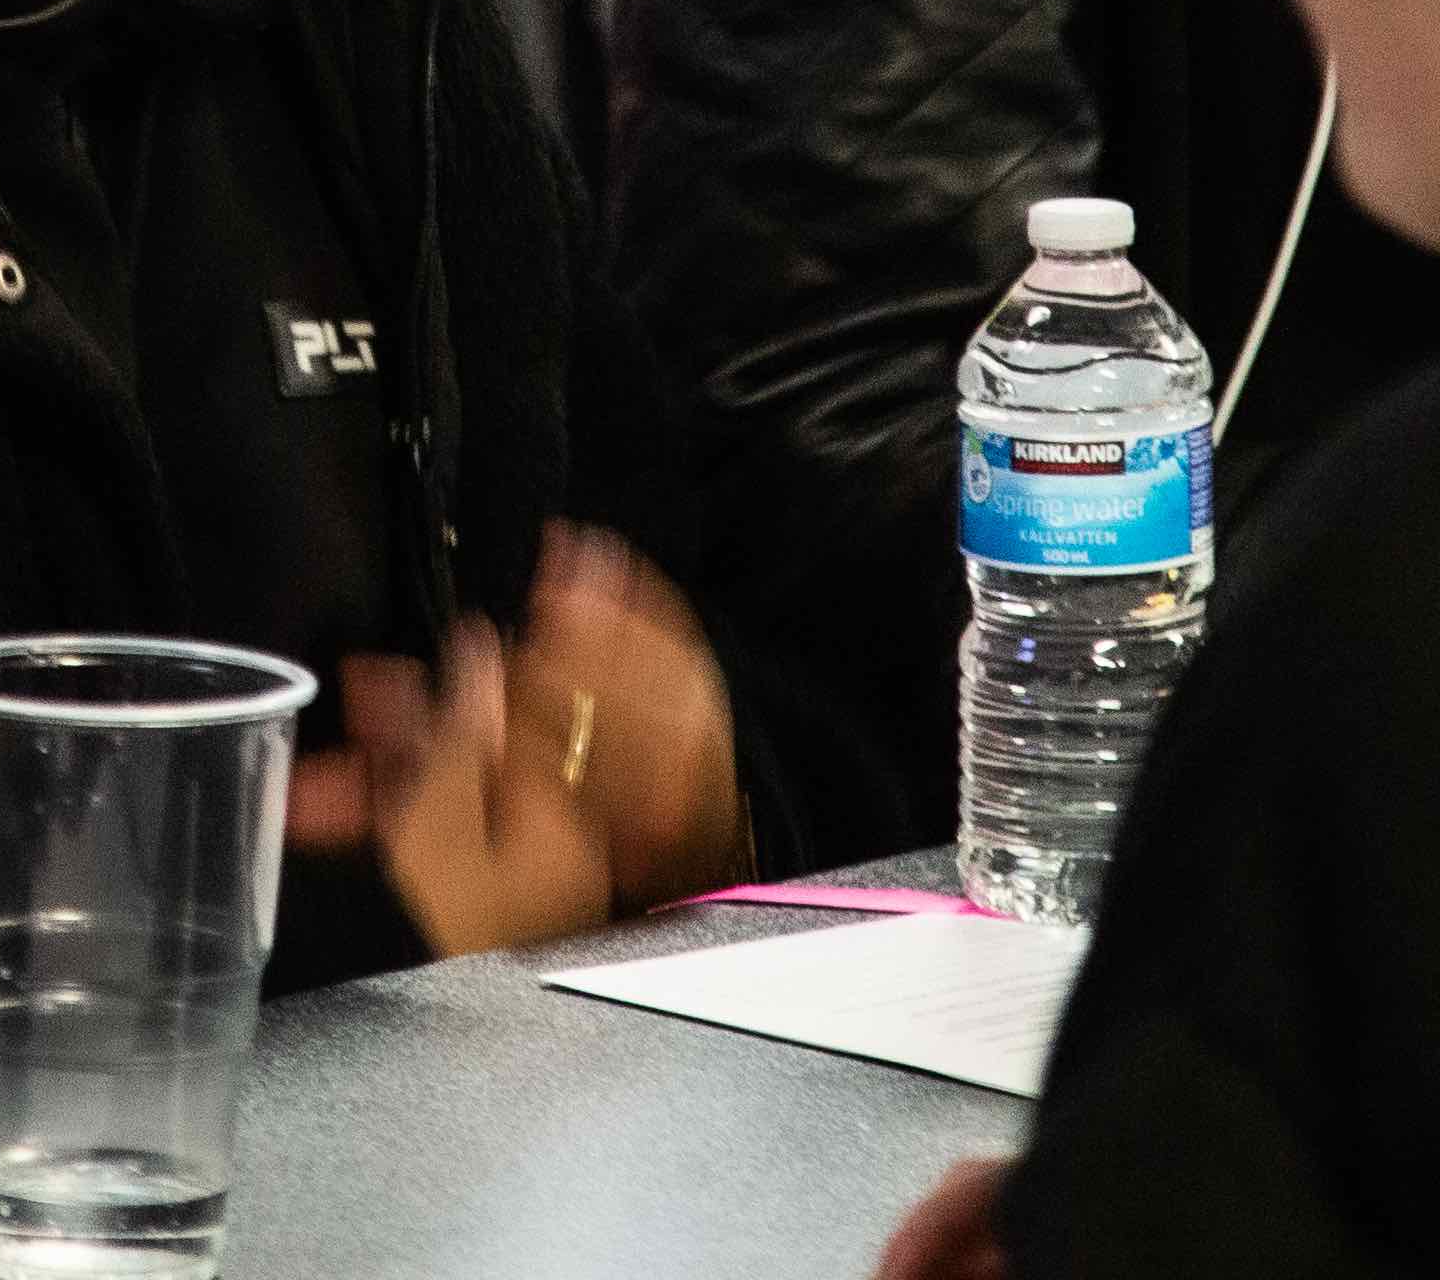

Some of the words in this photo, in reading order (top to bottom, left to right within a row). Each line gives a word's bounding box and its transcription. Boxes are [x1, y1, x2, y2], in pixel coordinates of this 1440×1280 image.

[1013, 441, 1122, 464] KIRKLAND
[994, 492, 1063, 526] spring
[1072, 494, 1146, 521] water
